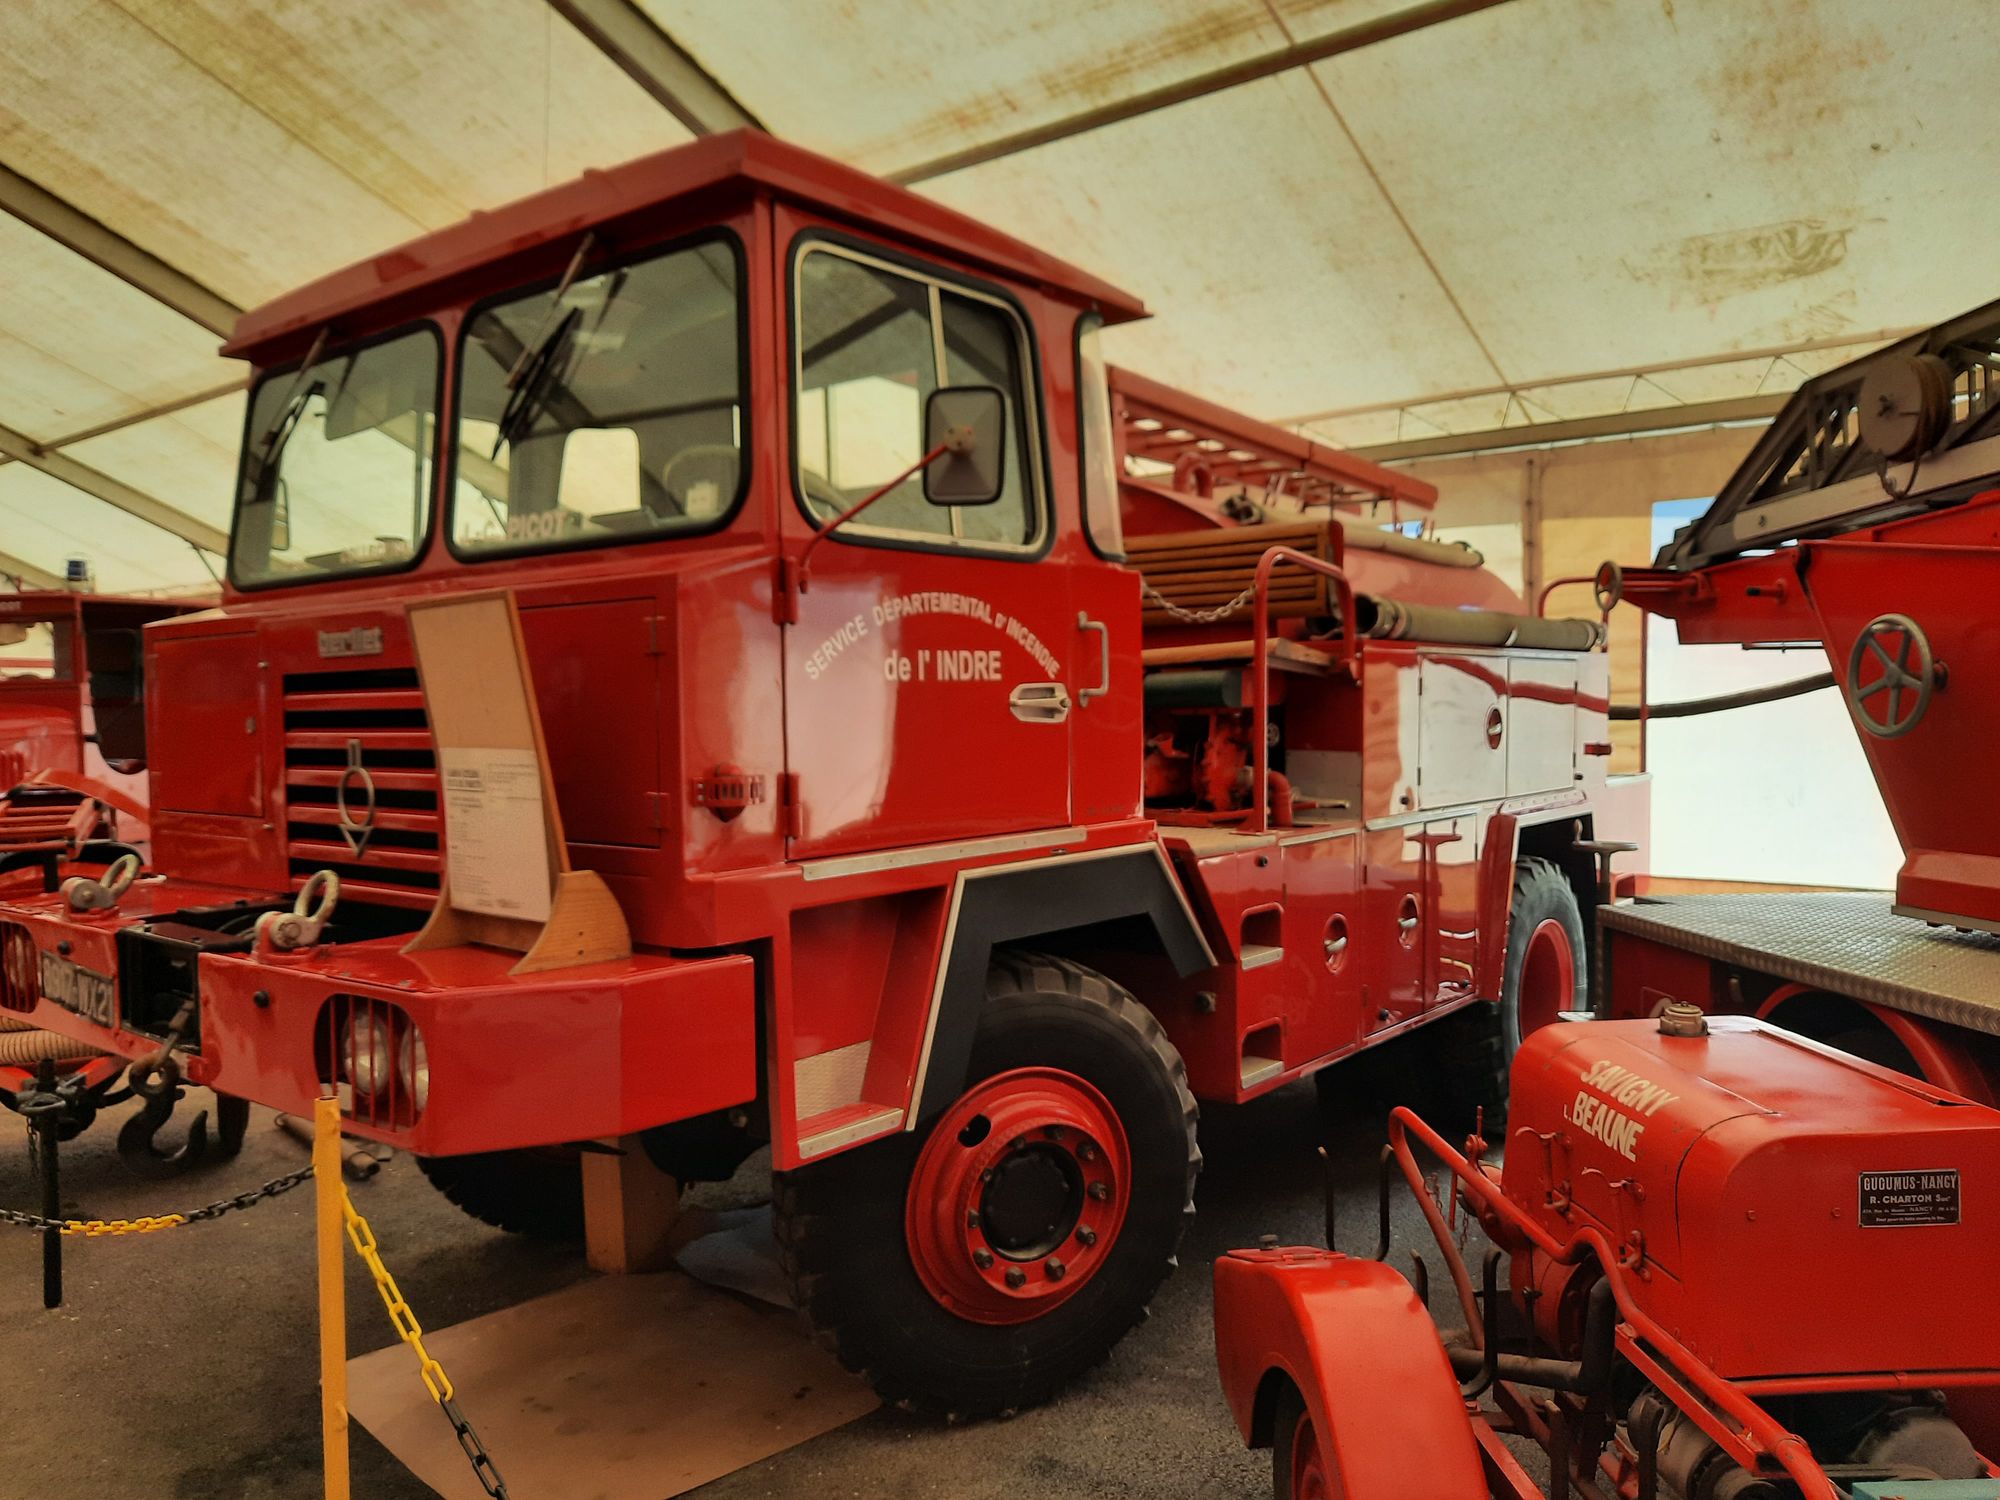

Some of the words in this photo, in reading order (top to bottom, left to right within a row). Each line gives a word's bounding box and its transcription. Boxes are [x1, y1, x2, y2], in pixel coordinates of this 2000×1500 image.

[508, 511, 568, 542] PICOT
[804, 614, 869, 680] SERVICE
[884, 650, 912, 681] de
[937, 650, 1003, 681] INDRE
[1580, 1060, 1680, 1118] SAVIGNY
[1572, 1090, 1645, 1163] BEAUNE
[1869, 1196, 1881, 1204] R.
[1882, 1194, 1932, 1204] CHARTON
